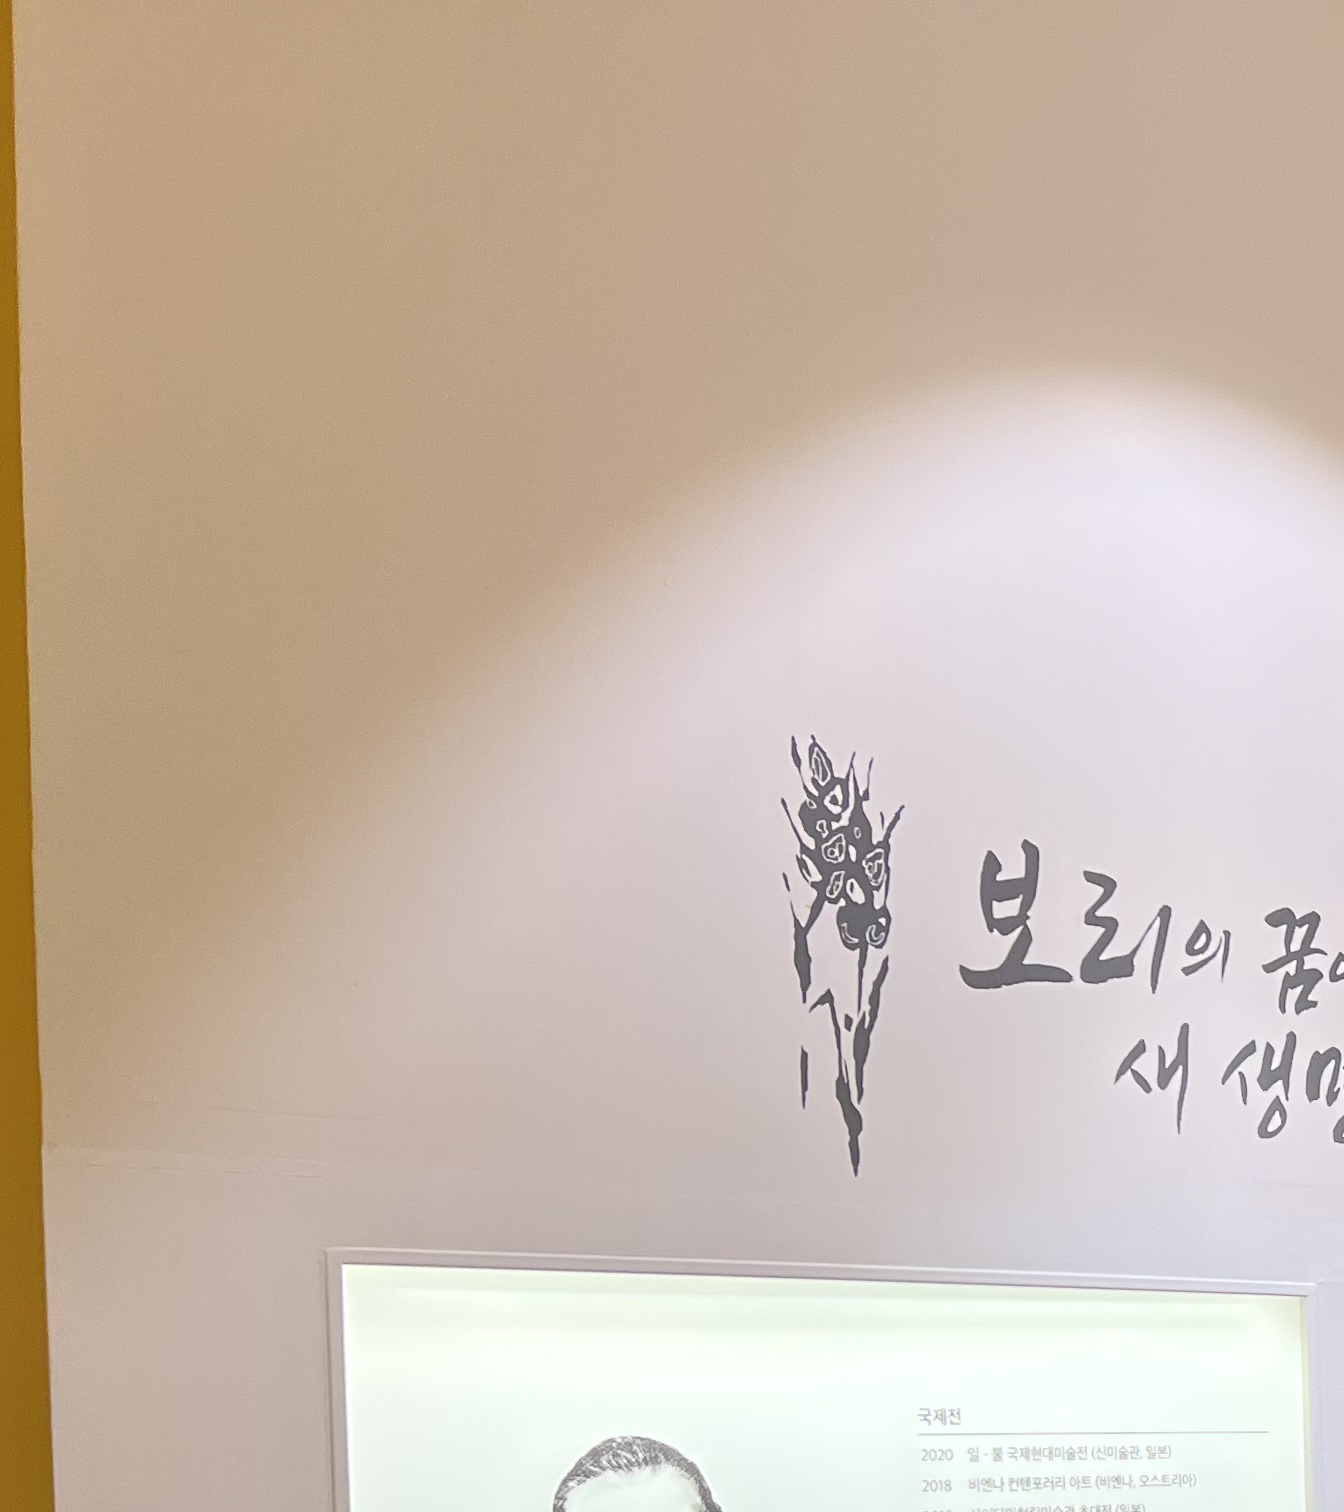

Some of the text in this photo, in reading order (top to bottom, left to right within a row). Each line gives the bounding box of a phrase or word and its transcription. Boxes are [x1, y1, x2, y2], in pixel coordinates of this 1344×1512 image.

[959, 839, 1232, 994] 보리의
[1114, 1023, 1189, 1134] 새
[918, 1408, 961, 1425] 국제전
[921, 1449, 953, 1462] 2020
[1007, 1446, 1088, 1461] 국제현대미술전
[922, 1479, 952, 1492] 2018
[968, 1477, 1005, 1493] 비엔나
[1008, 1476, 1066, 1492] 컨텐포러리
[1069, 1476, 1092, 1490] 아트
